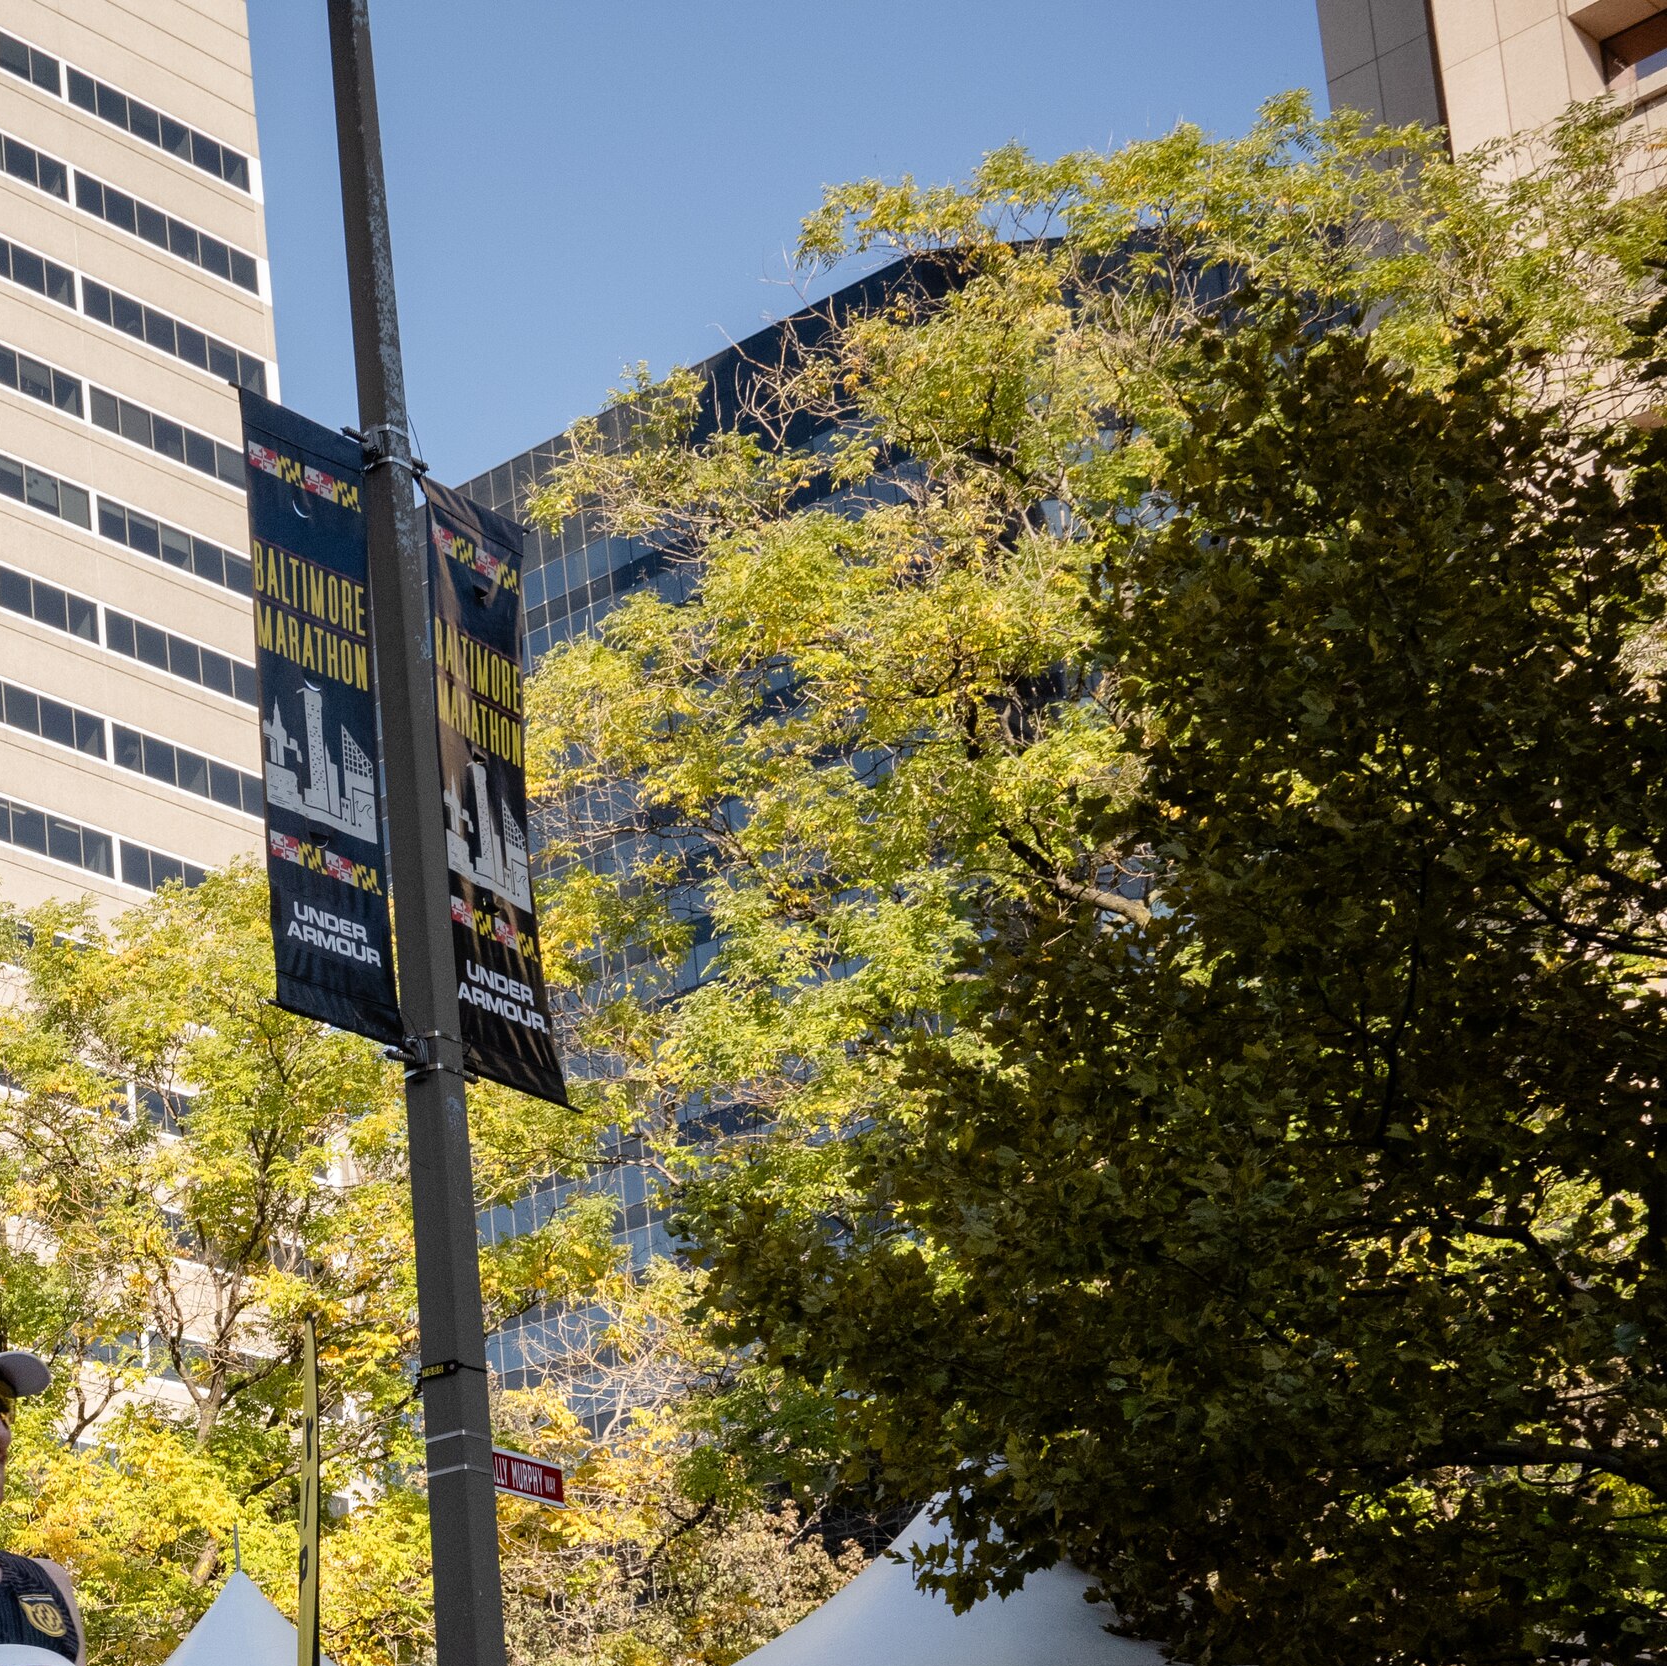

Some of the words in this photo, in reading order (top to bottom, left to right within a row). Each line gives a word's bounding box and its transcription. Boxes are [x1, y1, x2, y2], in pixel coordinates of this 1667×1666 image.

[253, 538, 366, 637] BALTIMORE
[257, 598, 369, 692] MARATHON
[434, 615, 521, 717] BALTIMORE
[437, 673, 522, 769] MARATHON
[286, 918, 382, 968] ARMOUR
[293, 900, 367, 943] UNDER
[458, 981, 547, 1033] ARMOUR
[466, 958, 534, 1006] UNDER
[493, 1456, 508, 1486] LLY
[510, 1460, 543, 1495] MURPHY
[544, 1475, 556, 1494] WAY
